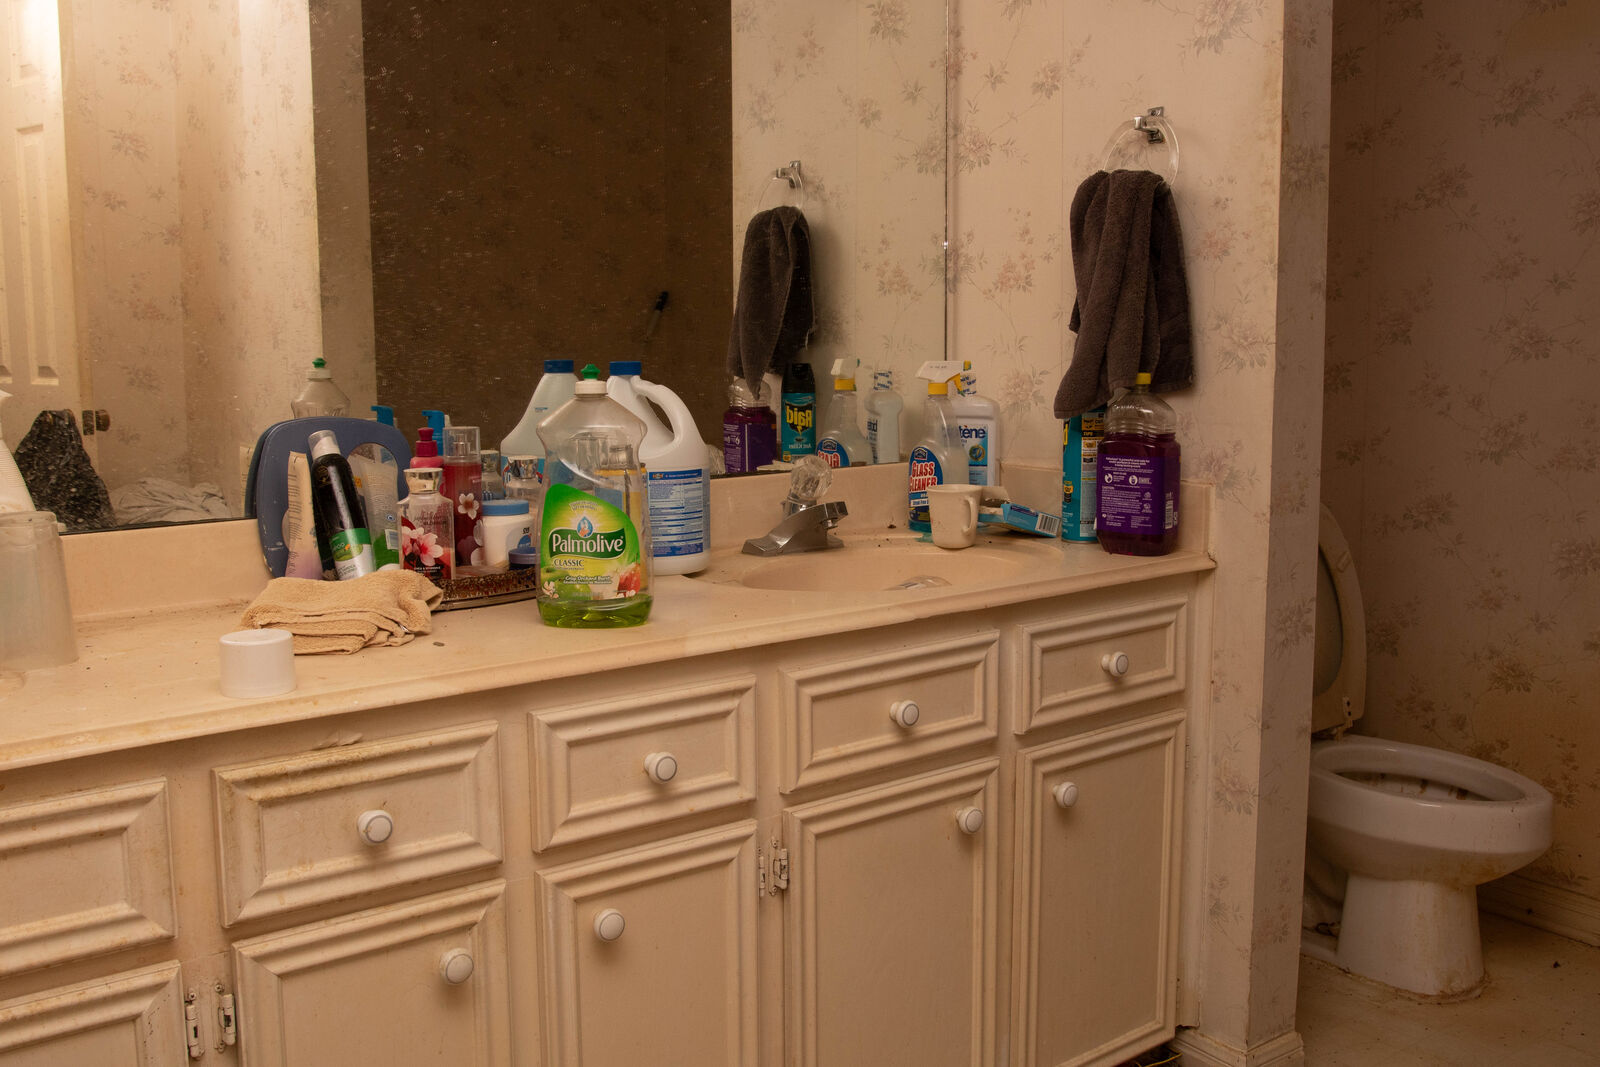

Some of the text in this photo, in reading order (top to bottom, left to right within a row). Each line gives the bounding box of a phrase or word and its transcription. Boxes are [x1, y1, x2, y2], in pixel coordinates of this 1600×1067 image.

[958, 425, 986, 440] tène
[911, 461, 935, 477] GLASS
[552, 533, 624, 552] Palmolive
[553, 559, 584, 567] CLASSIC
